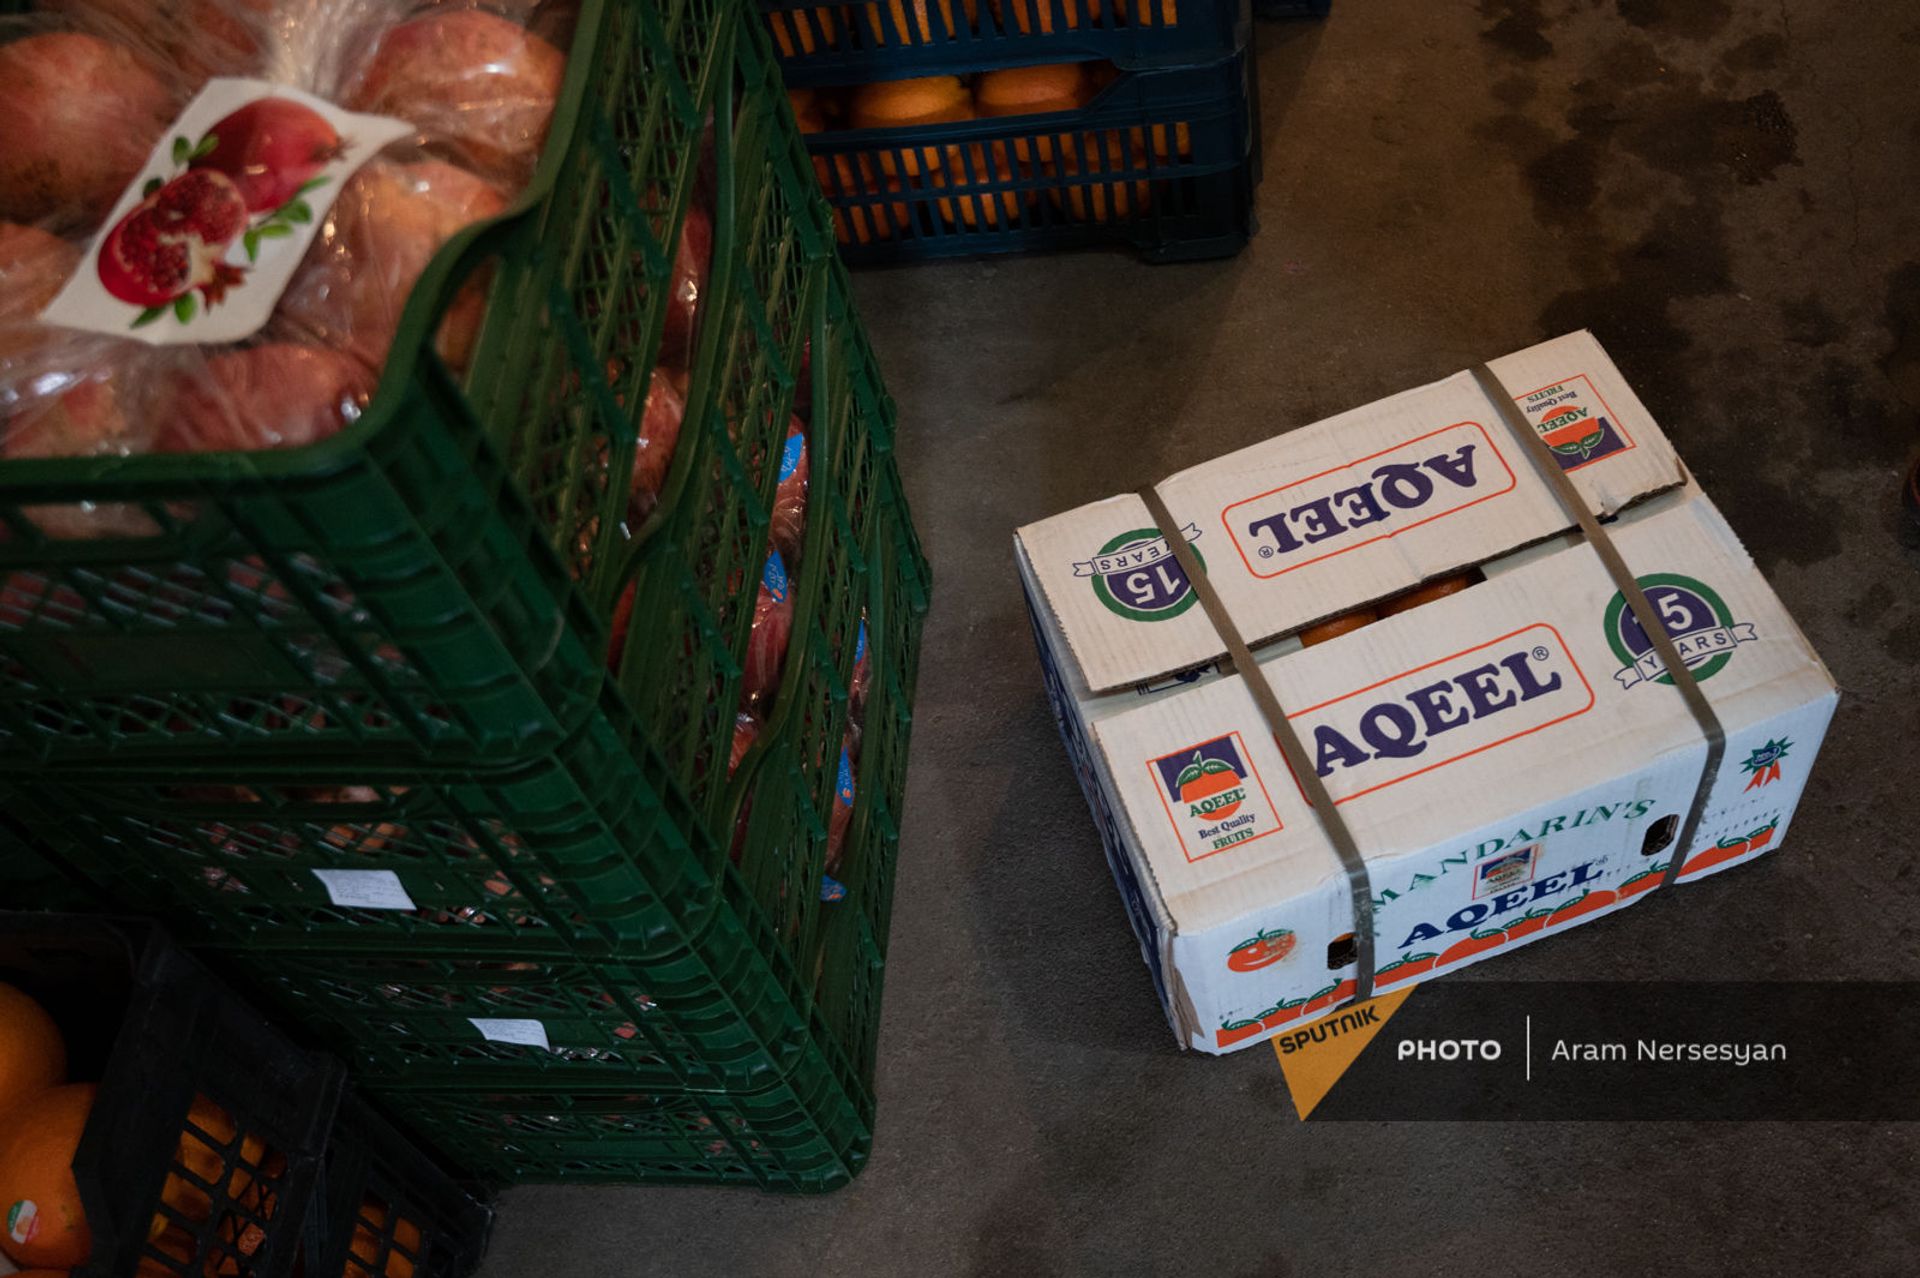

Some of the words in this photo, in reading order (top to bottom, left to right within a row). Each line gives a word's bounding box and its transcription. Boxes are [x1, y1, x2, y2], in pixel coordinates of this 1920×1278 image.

[1526, 385, 1564, 403] FRUITS
[1526, 399, 1559, 413] Quality
[1537, 406, 1588, 433] AQEEL
[1126, 564, 1180, 604] 15
[1632, 592, 1693, 630] 5
[1643, 632, 1728, 670] YARS
[1190, 787, 1247, 818] AQEEL
[1198, 825, 1221, 840] Best
[1220, 813, 1256, 832] Quality
[1212, 827, 1255, 850] FRUITS
[1371, 799, 1657, 913] MANDARIN'S
[1397, 862, 1604, 950] AQEEL
